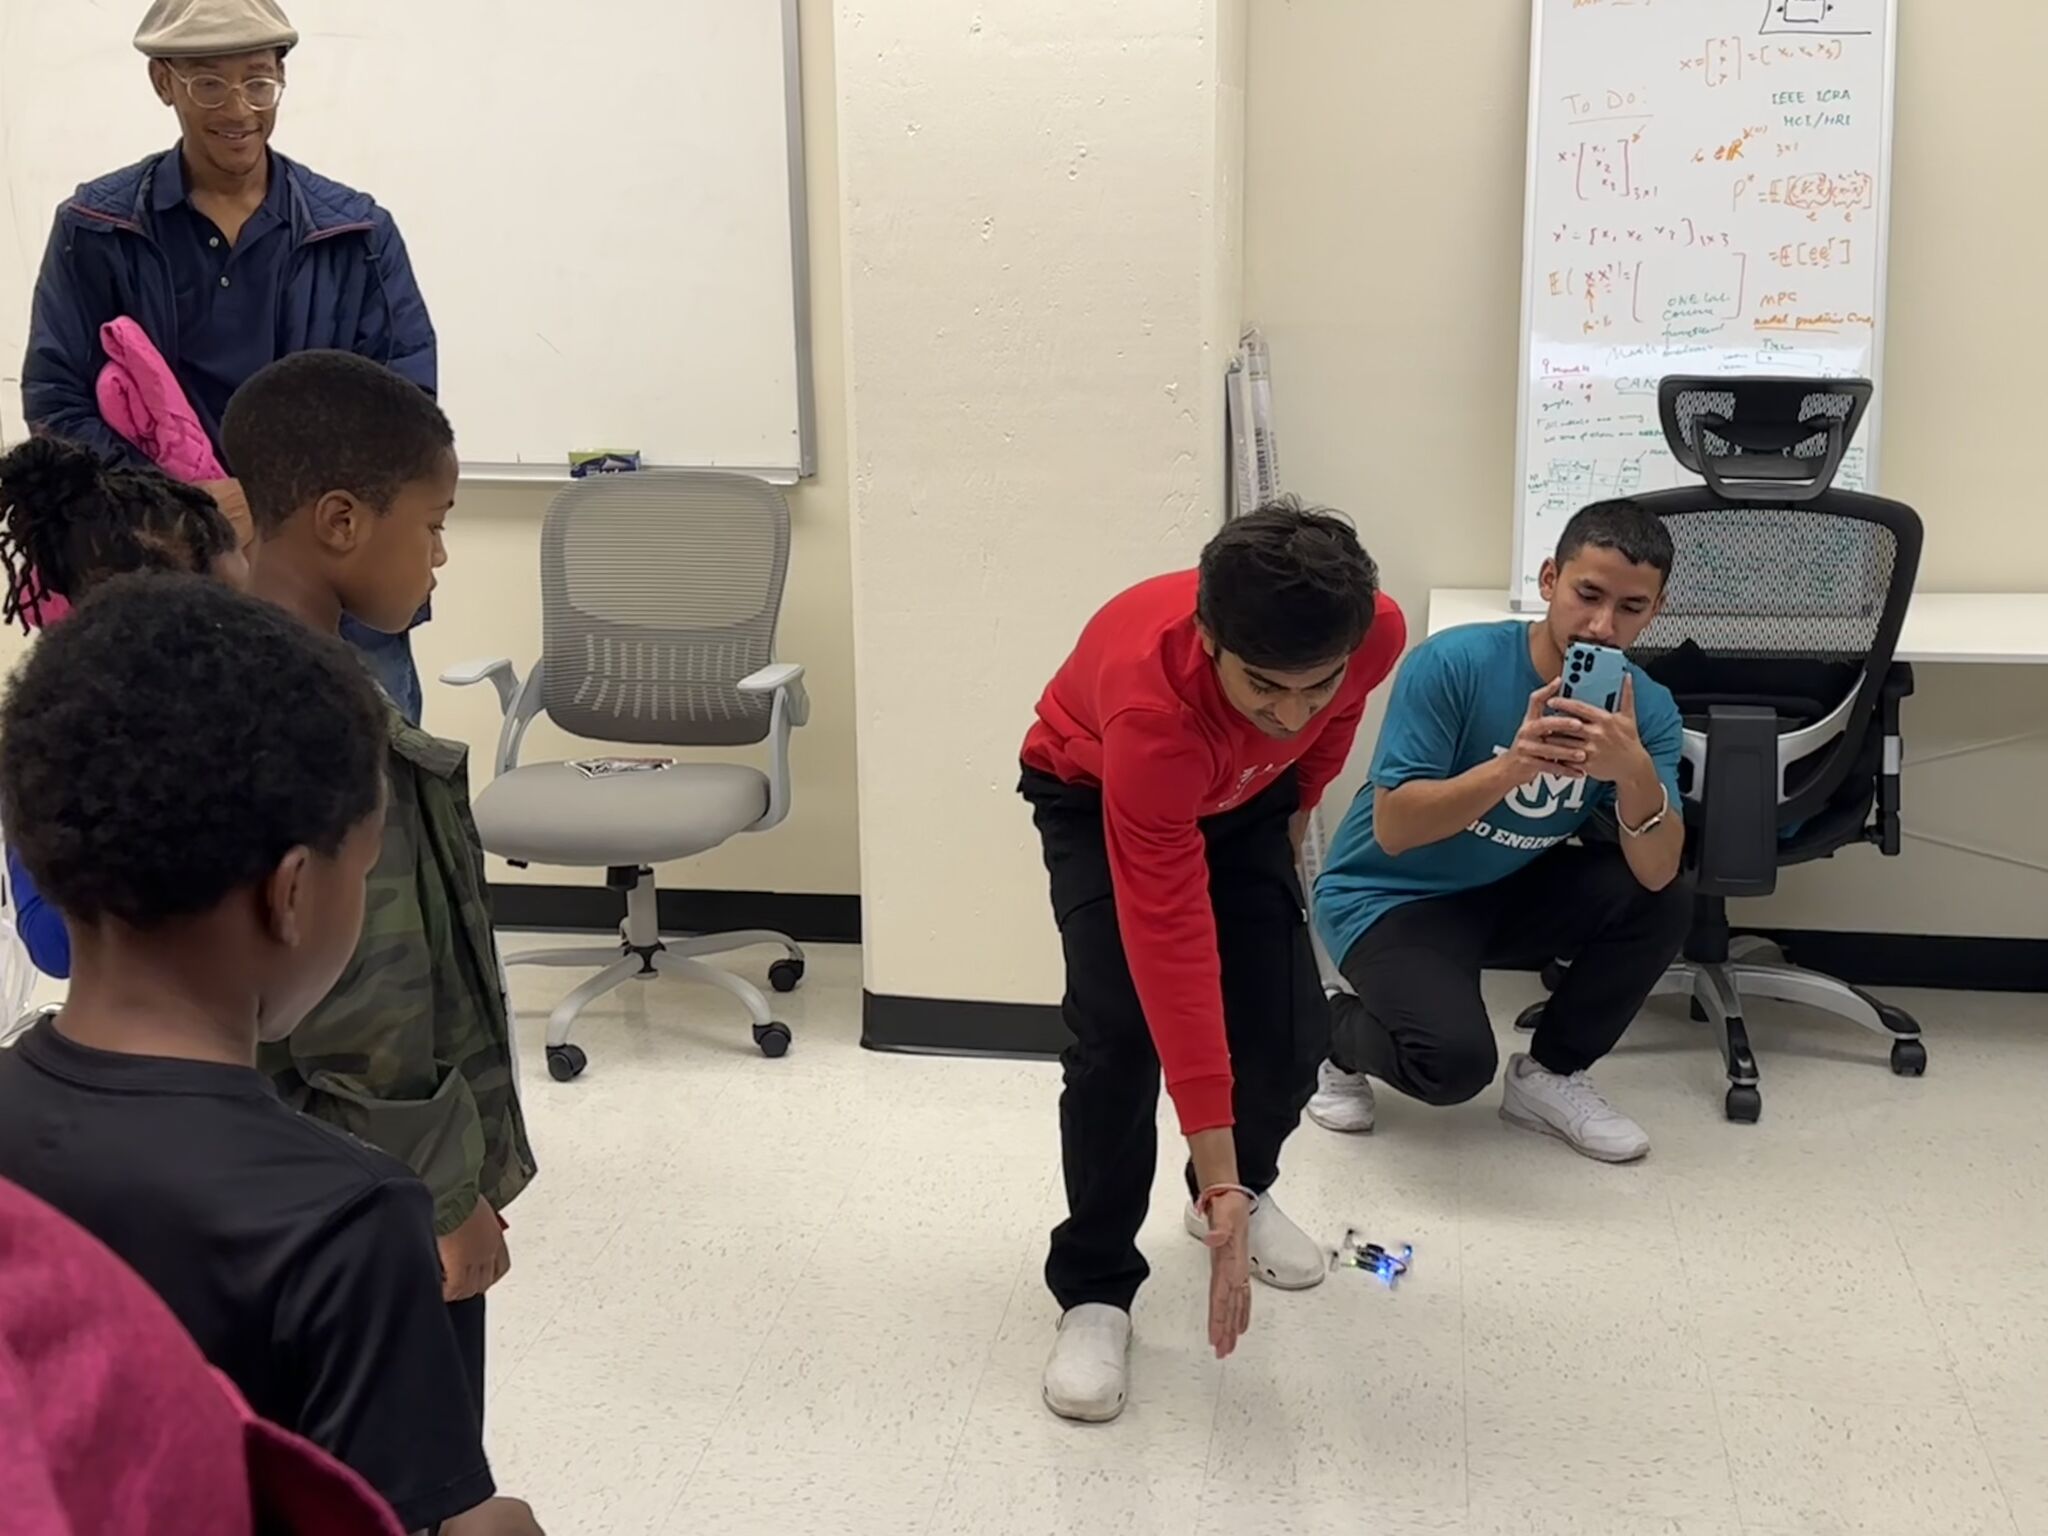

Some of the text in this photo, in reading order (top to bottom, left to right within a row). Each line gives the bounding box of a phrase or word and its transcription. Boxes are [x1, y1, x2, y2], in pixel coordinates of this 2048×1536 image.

[1560, 94, 1590, 114] To
[1771, 89, 1851, 105] IEEE ICRA
[1760, 292, 1797, 307] MPC
